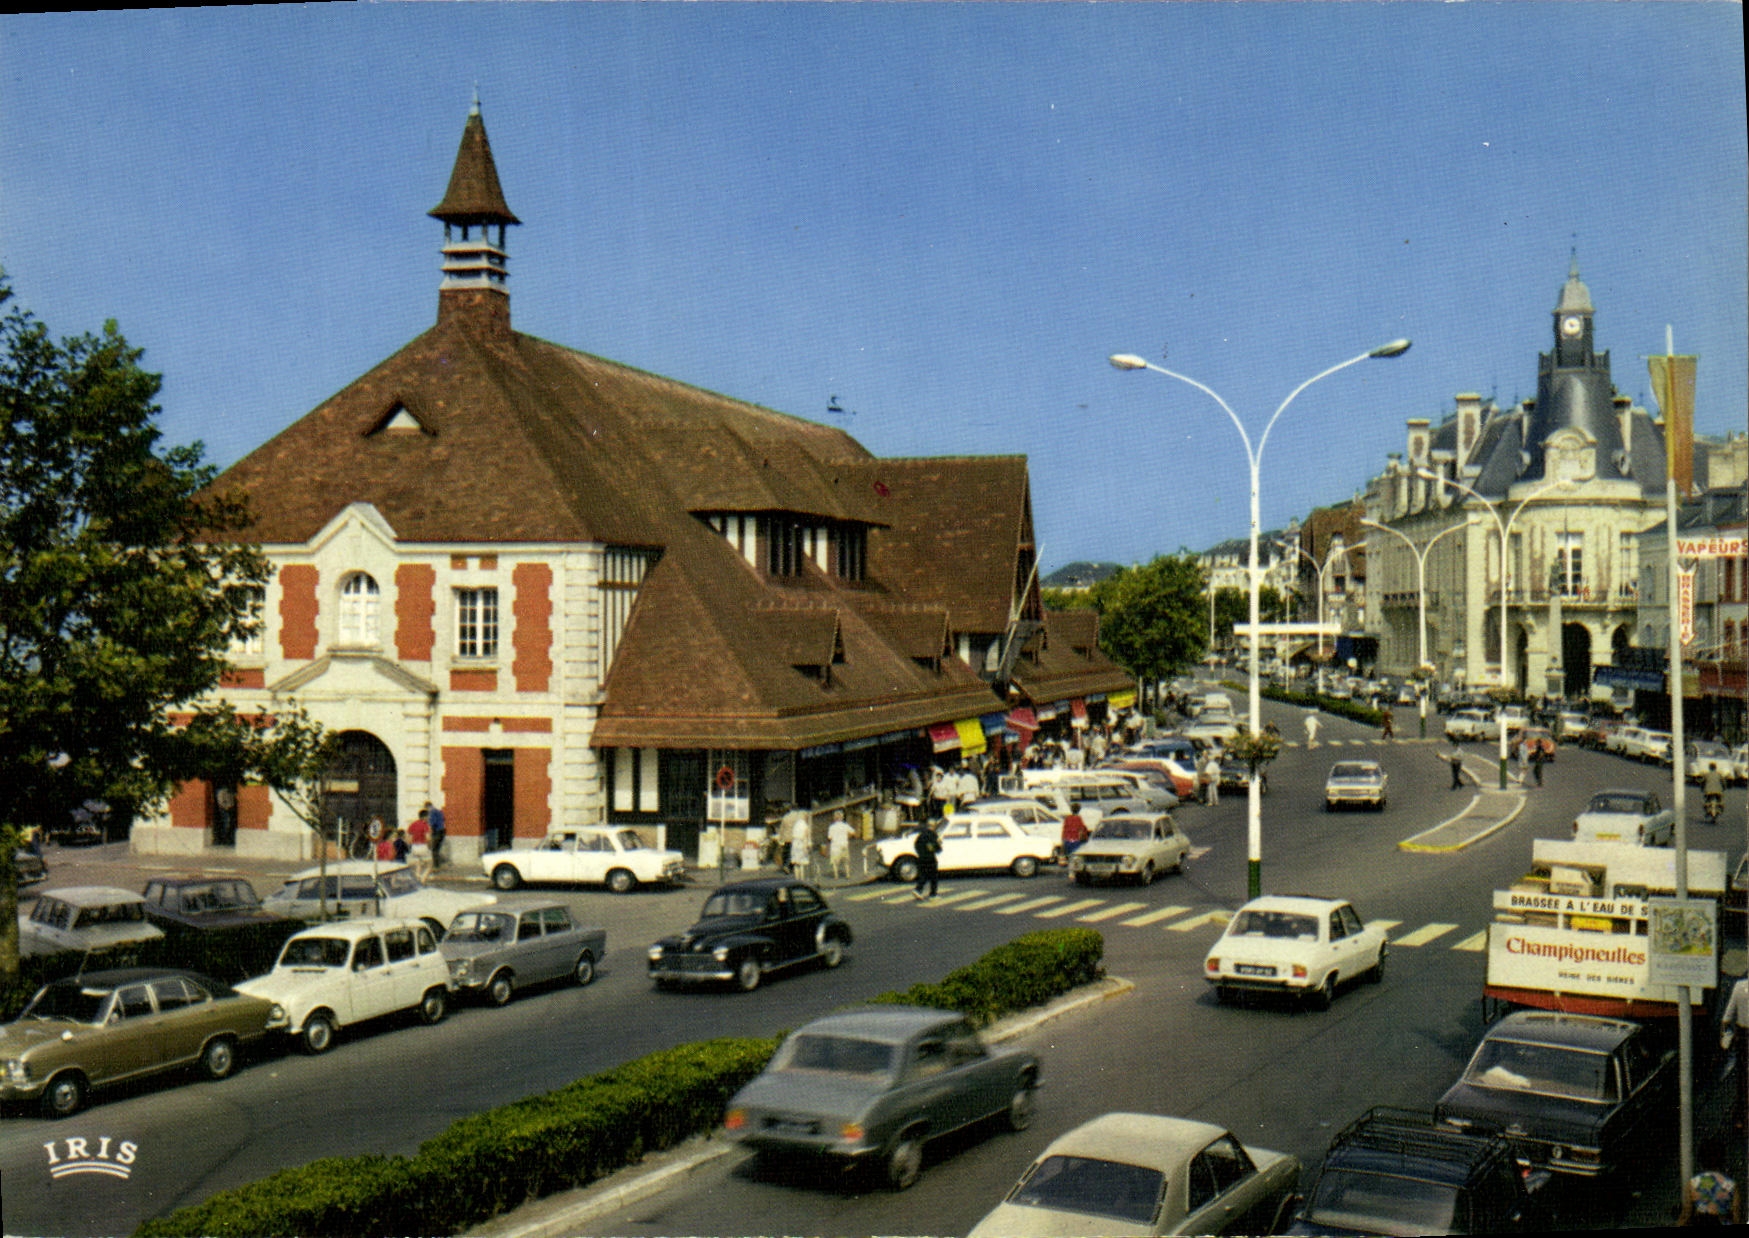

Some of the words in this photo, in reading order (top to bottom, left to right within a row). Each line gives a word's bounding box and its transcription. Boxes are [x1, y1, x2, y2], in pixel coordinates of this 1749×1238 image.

[1677, 539, 1748, 554] VAPEURS
[1620, 904, 1635, 915] DE
[1506, 938, 1646, 965] Champigneulles
